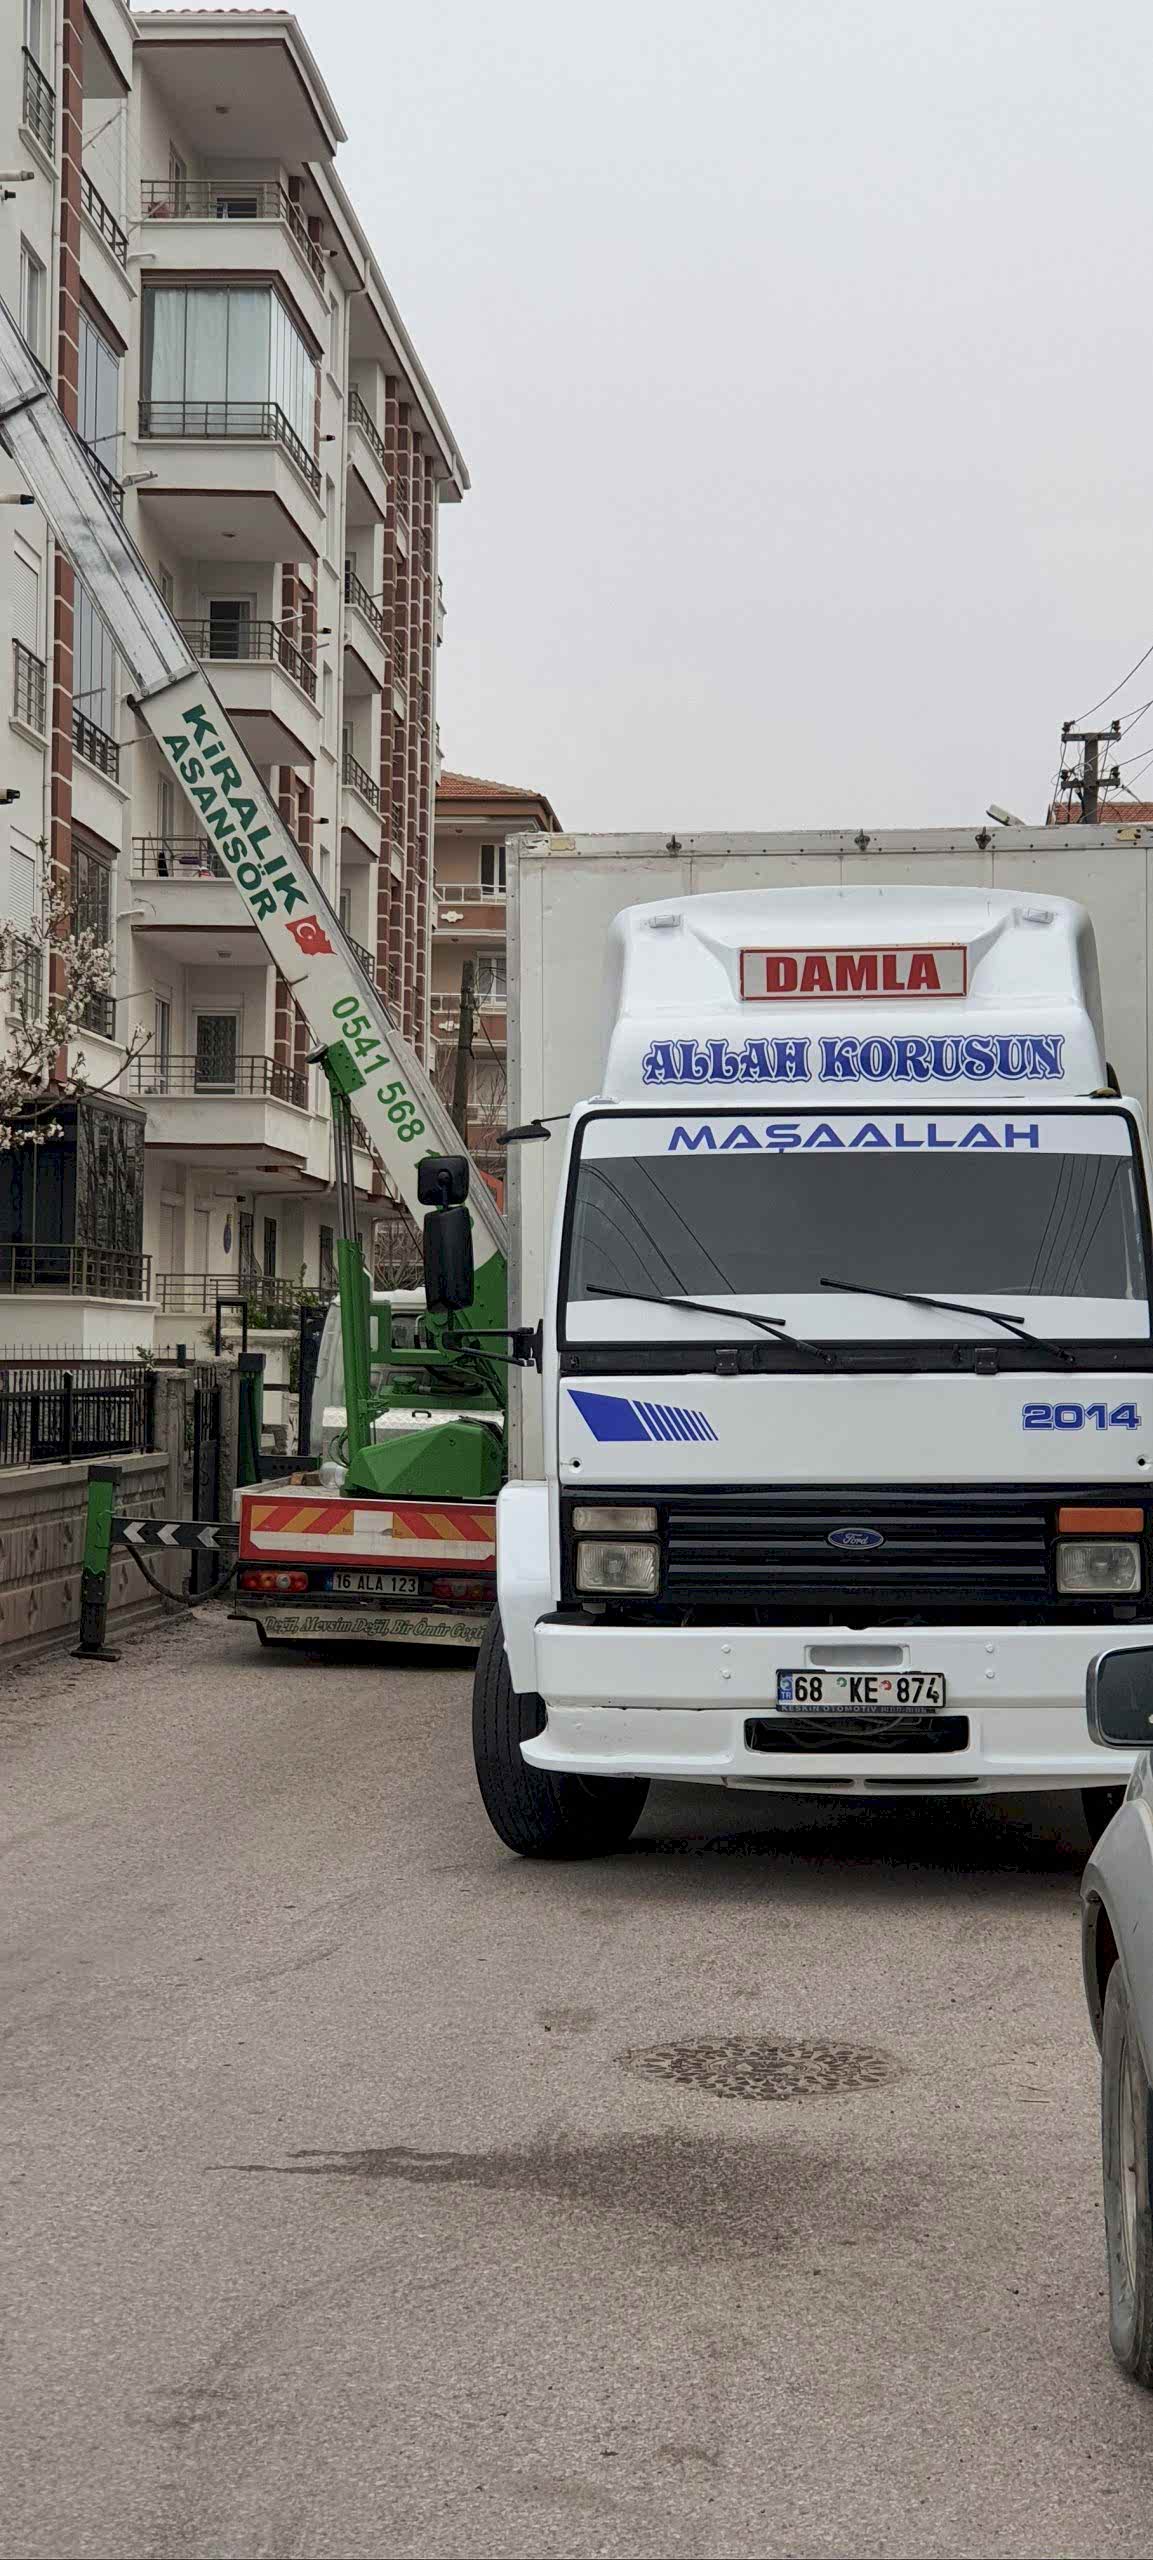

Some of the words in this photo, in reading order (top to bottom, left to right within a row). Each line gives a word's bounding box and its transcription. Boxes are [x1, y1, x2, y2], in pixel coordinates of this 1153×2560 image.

[182, 703, 309, 915] KİRALIK
[162, 735, 278, 921] ASANSÖR
[766, 953, 941, 992] DAMLA
[332, 996, 390, 1074] 0541
[377, 1081, 425, 1142] 568
[642, 1037, 812, 1084] ALLAH
[818, 1034, 1065, 1082] KORUSUN
[668, 1123, 1039, 1153] MAŞAALLAH
[1022, 1403, 1141, 1431] 2014
[337, 1574, 351, 1589] 16
[357, 1575, 383, 1591] ALA
[392, 1577, 416, 1593] 123
[391, 1619, 412, 1635] Bir
[781, 1691, 792, 1700] TR
[795, 1676, 822, 1702] 68
[850, 1677, 878, 1703] KE
[897, 1677, 939, 1703] 874
